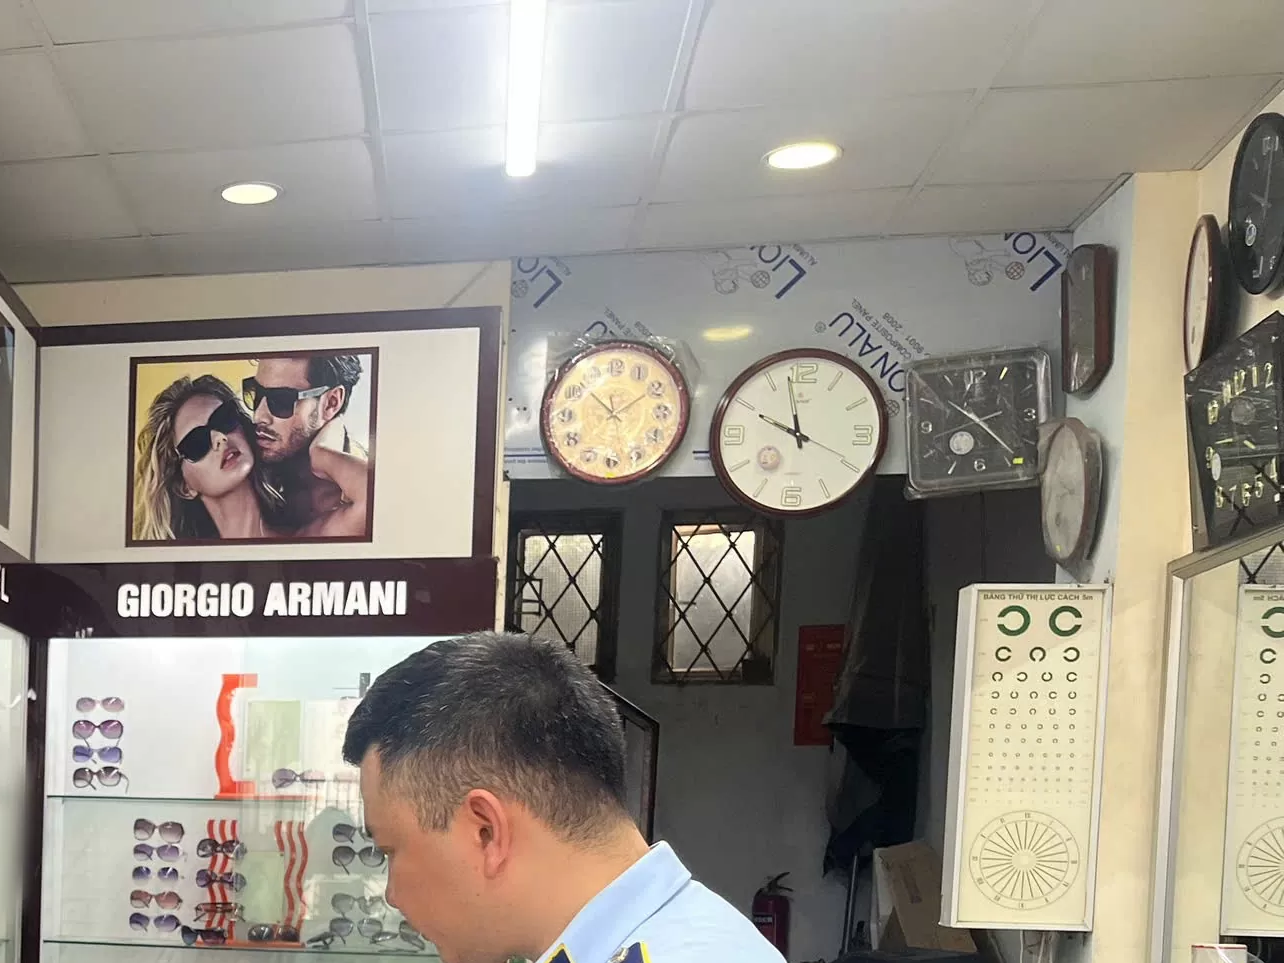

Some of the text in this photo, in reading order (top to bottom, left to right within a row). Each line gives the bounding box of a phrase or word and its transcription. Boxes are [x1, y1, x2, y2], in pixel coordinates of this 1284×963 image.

[790, 363, 818, 384] 12
[723, 425, 745, 446] 9
[852, 425, 873, 446] 3
[781, 486, 802, 507] 6
[117, 580, 407, 618] GIORGIO ARMANI
